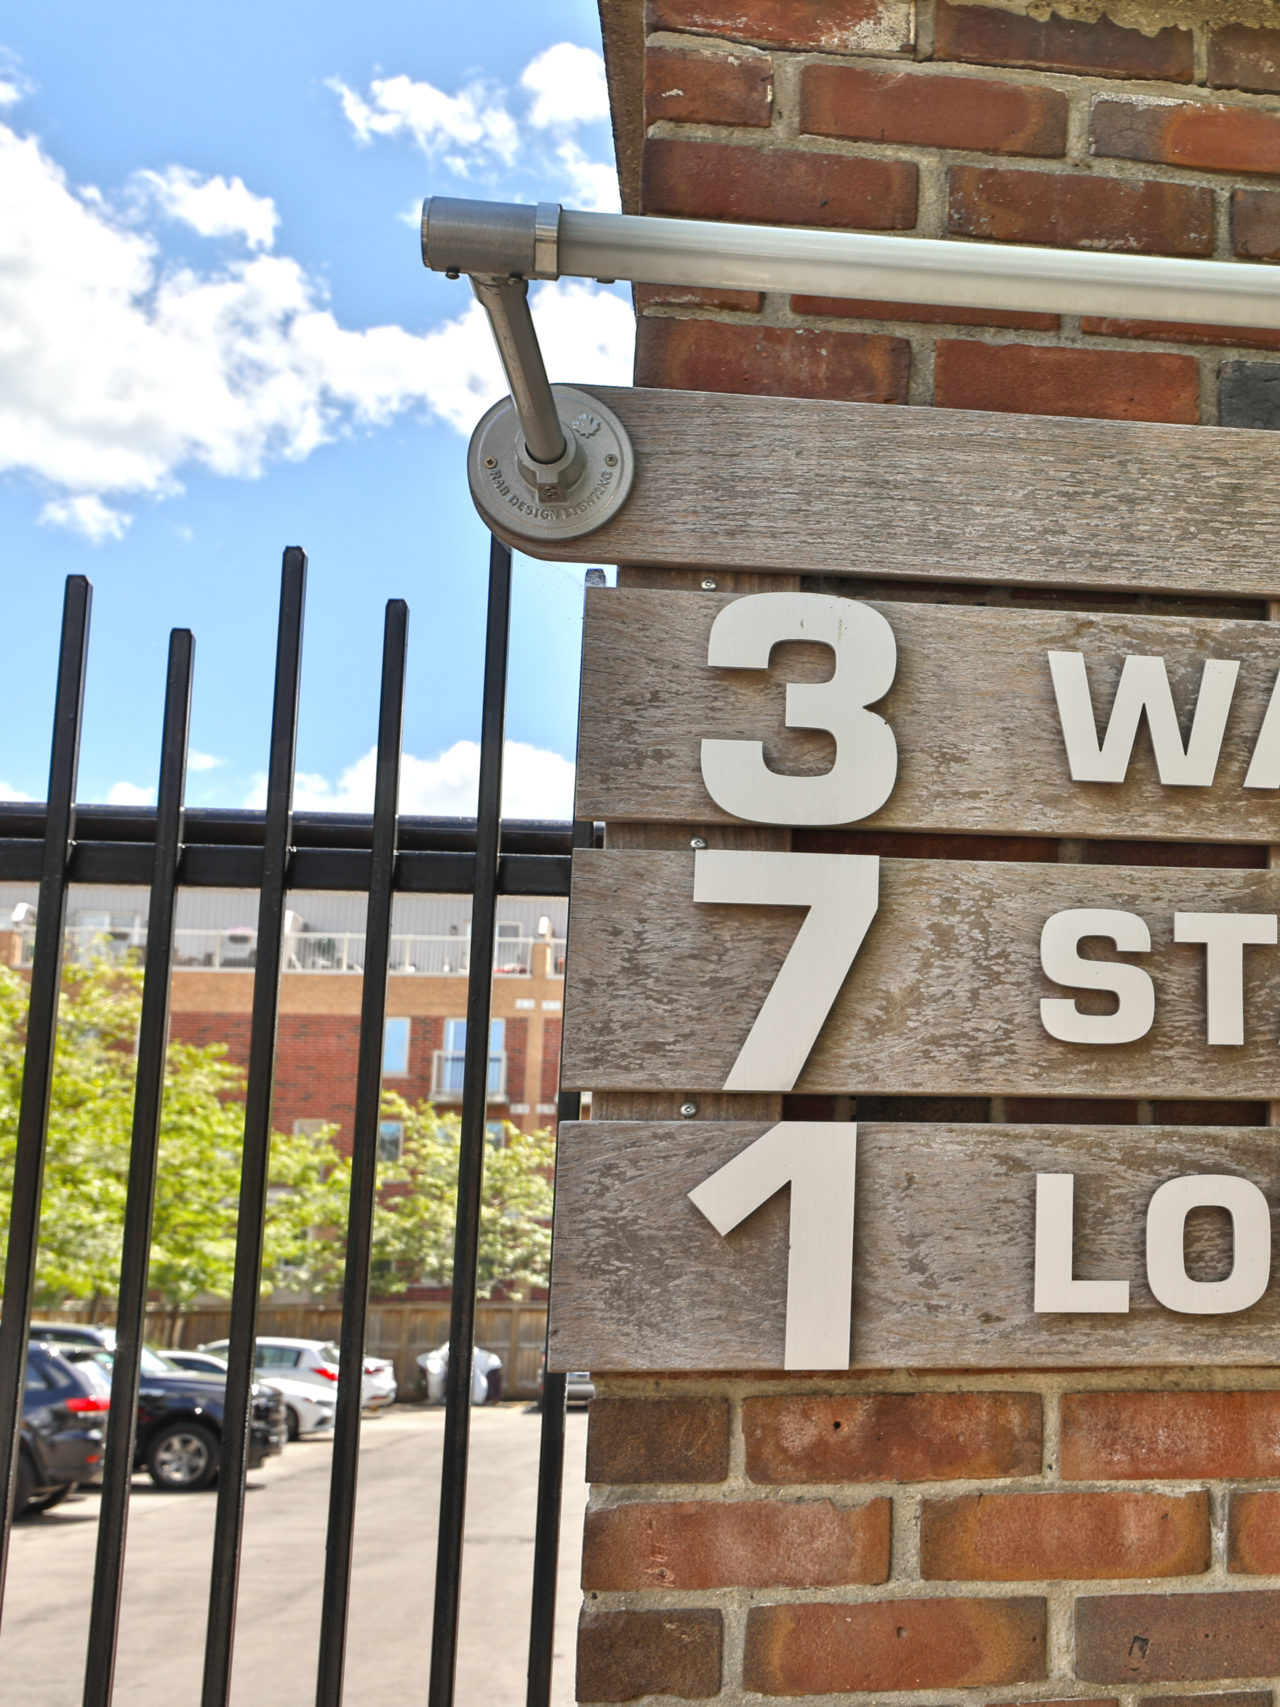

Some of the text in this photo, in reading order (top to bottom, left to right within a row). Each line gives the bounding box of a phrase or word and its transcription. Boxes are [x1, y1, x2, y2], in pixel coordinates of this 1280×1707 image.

[505, 493, 560, 521] DESIGN
[561, 469, 614, 521] LIGHTING
[700, 591, 898, 827] 3
[693, 848, 880, 1092] 7
[686, 1120, 858, 1371] 1
